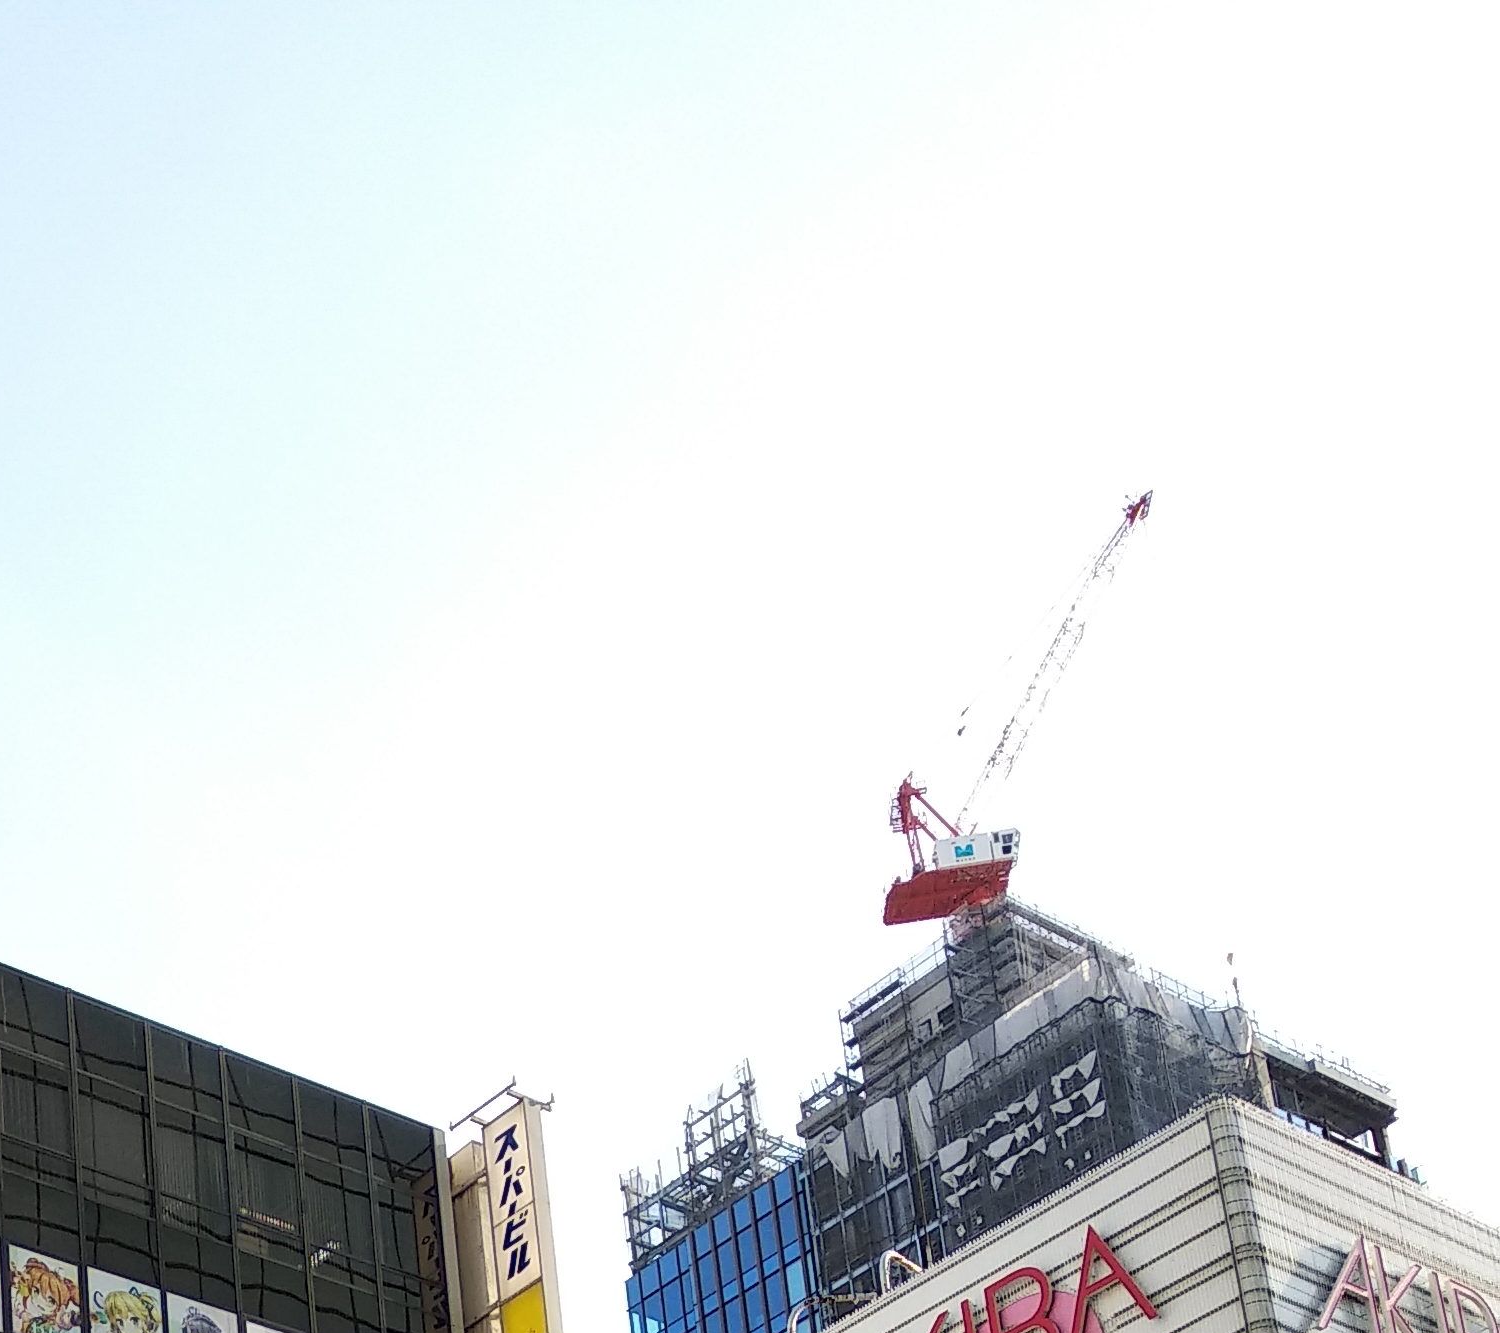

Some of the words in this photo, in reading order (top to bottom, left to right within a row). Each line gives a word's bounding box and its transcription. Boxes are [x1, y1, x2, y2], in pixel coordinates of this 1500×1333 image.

[494, 1126, 531, 1280] スーパービル
